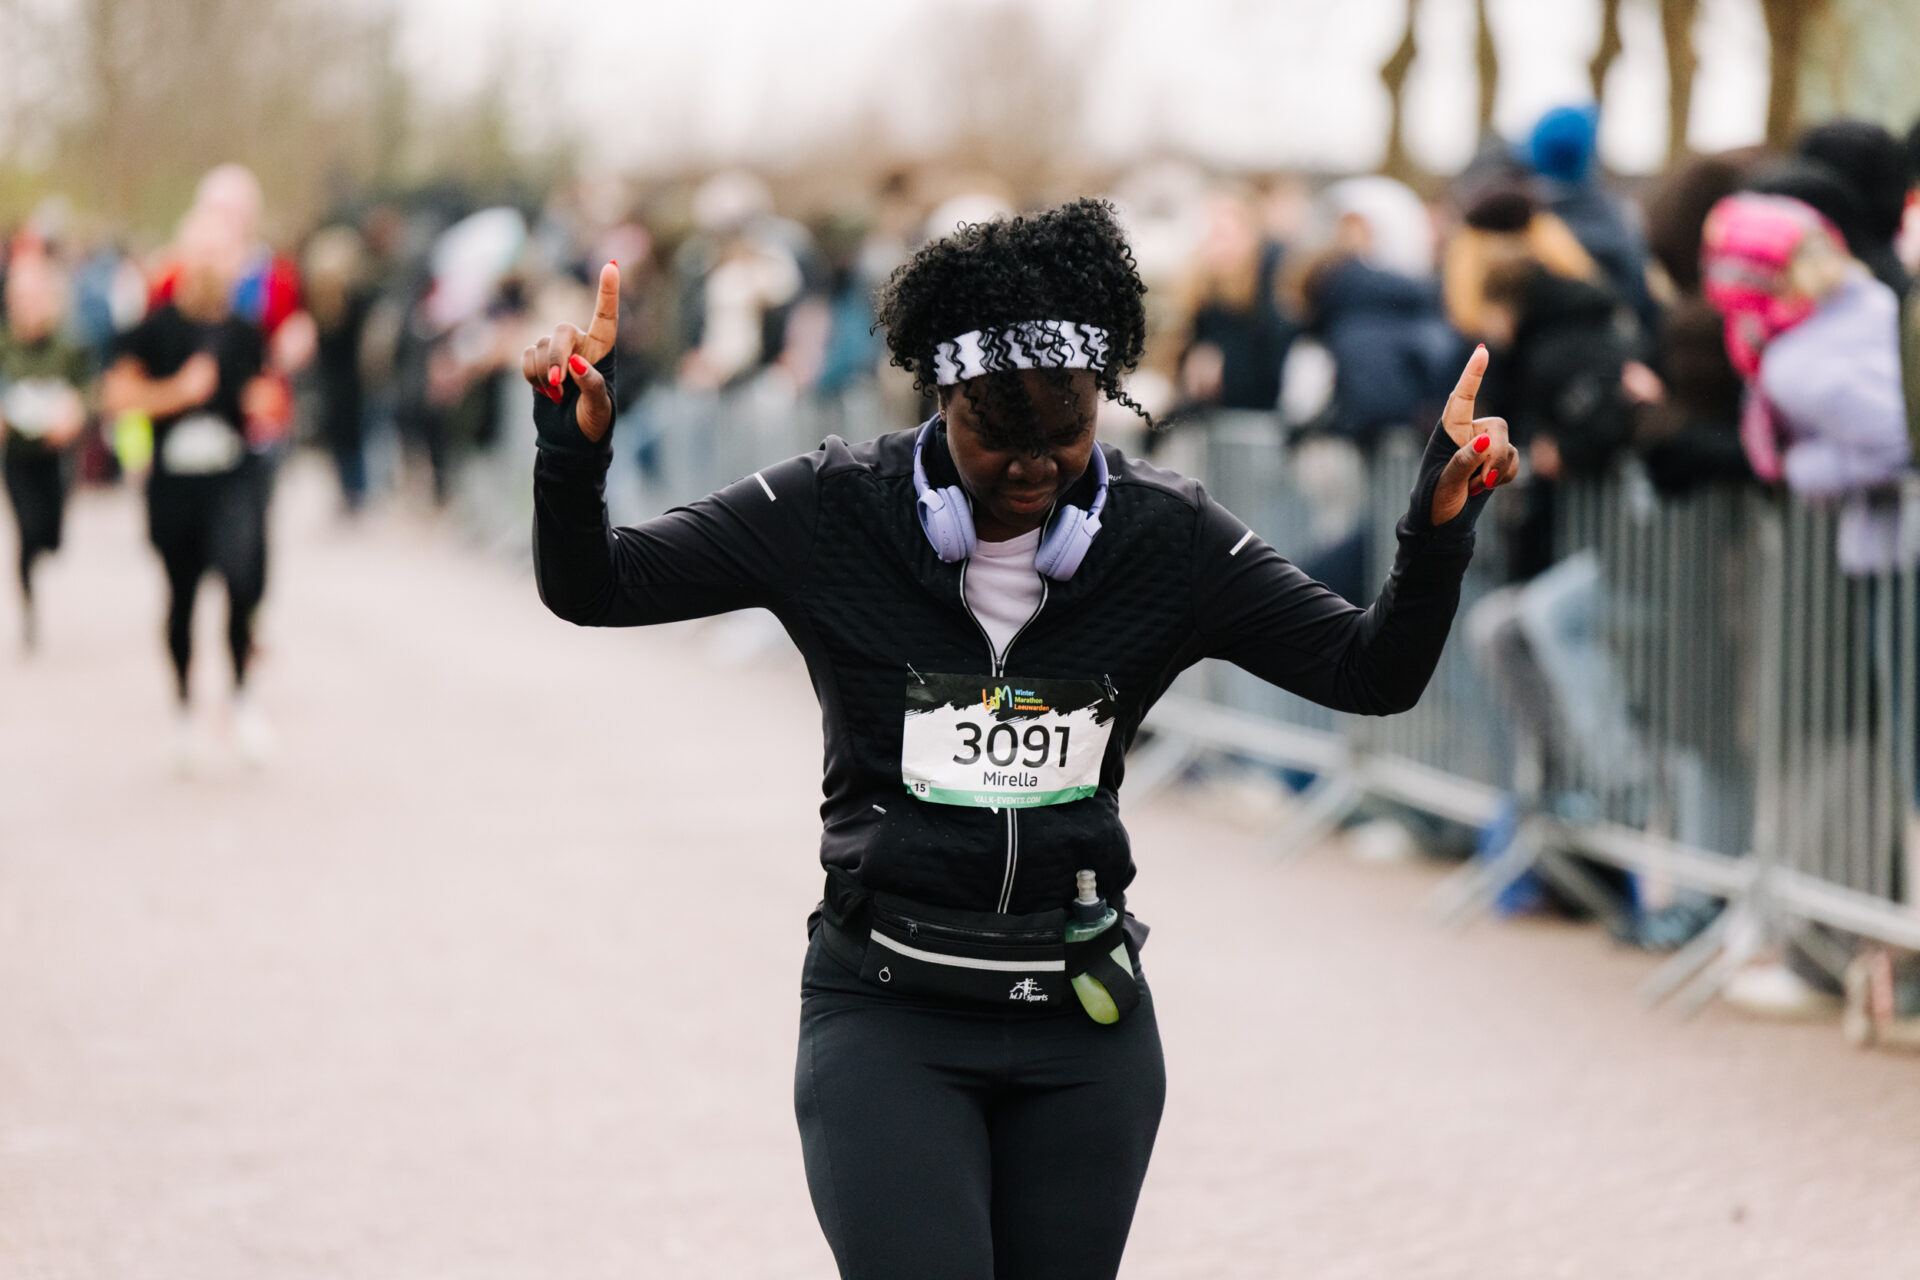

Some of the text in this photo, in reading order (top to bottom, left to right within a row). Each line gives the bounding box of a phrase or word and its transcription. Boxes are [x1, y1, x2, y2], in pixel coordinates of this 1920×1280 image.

[953, 722, 1070, 768] 3091
[984, 772, 1038, 787] Mirella
[914, 783, 926, 792] 15
[974, 795, 1042, 804] VALK-EVENTS.COM
